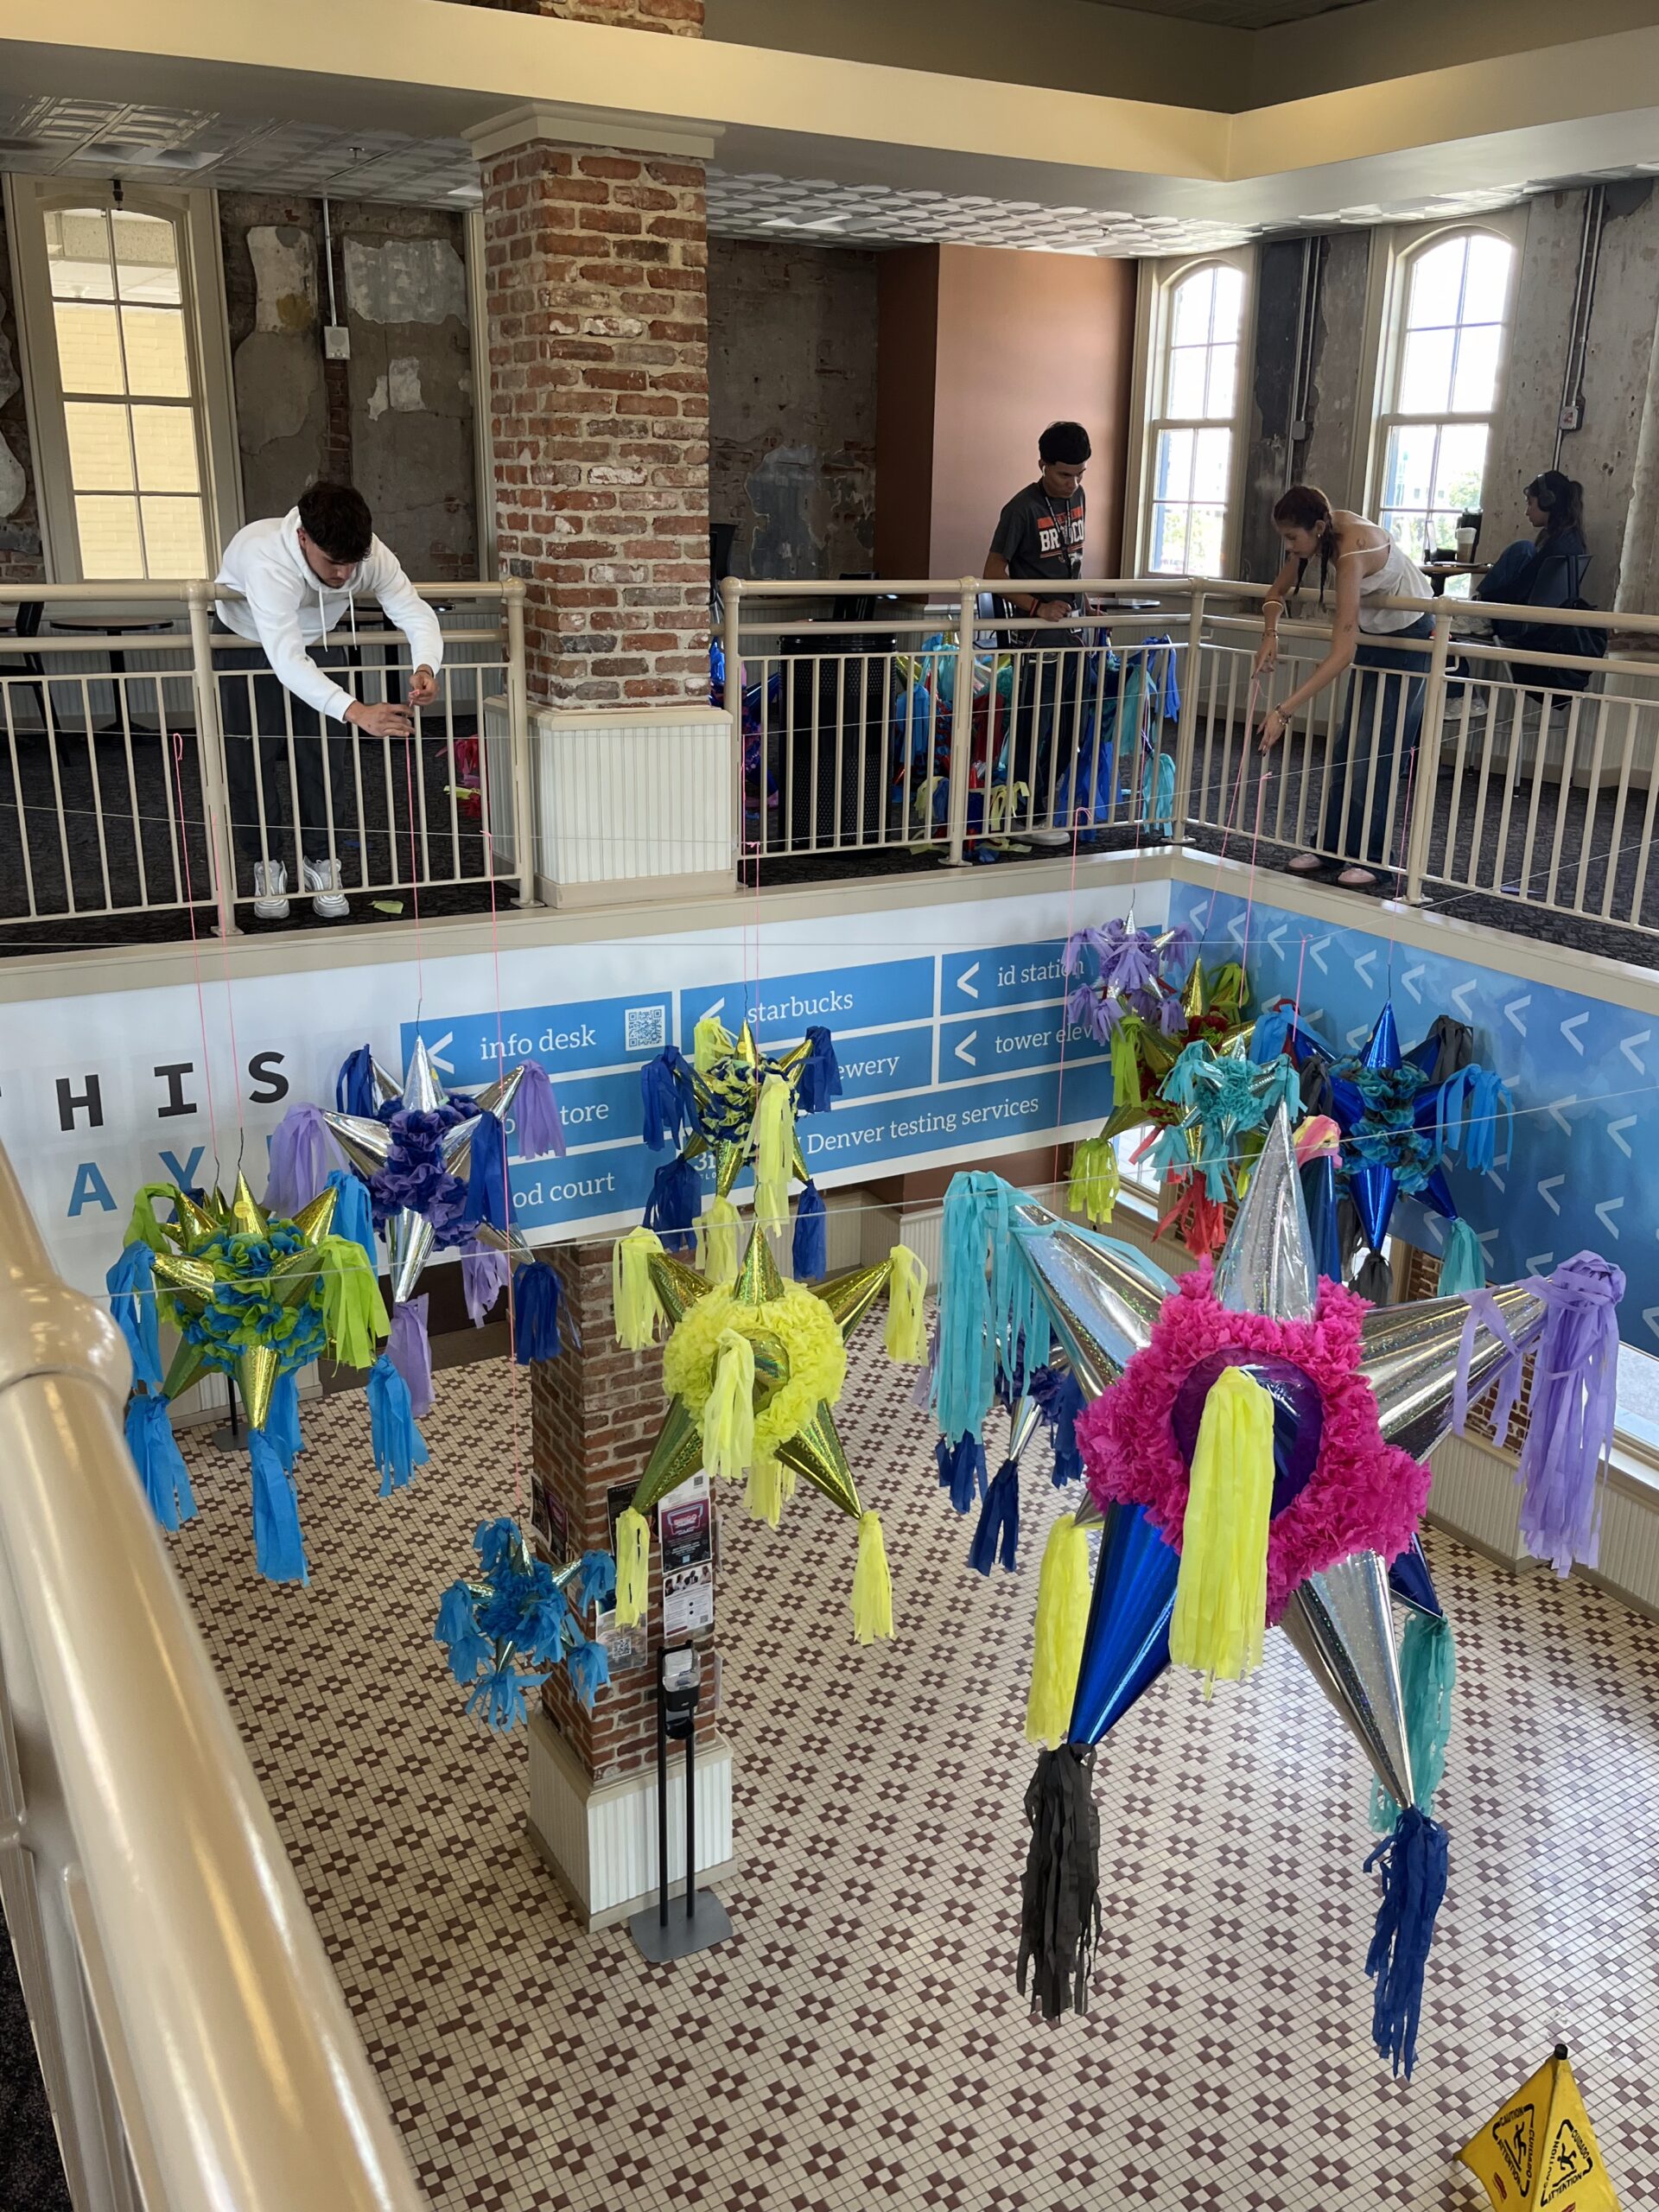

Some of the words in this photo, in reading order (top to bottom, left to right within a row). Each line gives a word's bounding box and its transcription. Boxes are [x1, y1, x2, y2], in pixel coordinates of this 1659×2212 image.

[997, 962, 1016, 988] id
[747, 990, 854, 1024] starbucks
[480, 1033, 533, 1060] info
[538, 1025, 596, 1052] desk
[995, 1031, 1052, 1054] tower
[838, 1056, 900, 1080] ewery
[807, 1126, 885, 1154] Denver
[890, 1109, 957, 1138] testing
[961, 1096, 1039, 1125] services
[550, 1172, 616, 1202] court
[1499, 2107, 1524, 2126] CAUTION
[1526, 2129, 1535, 2178] CUIDADO
[1571, 2128, 1590, 2159] CUIDADO
